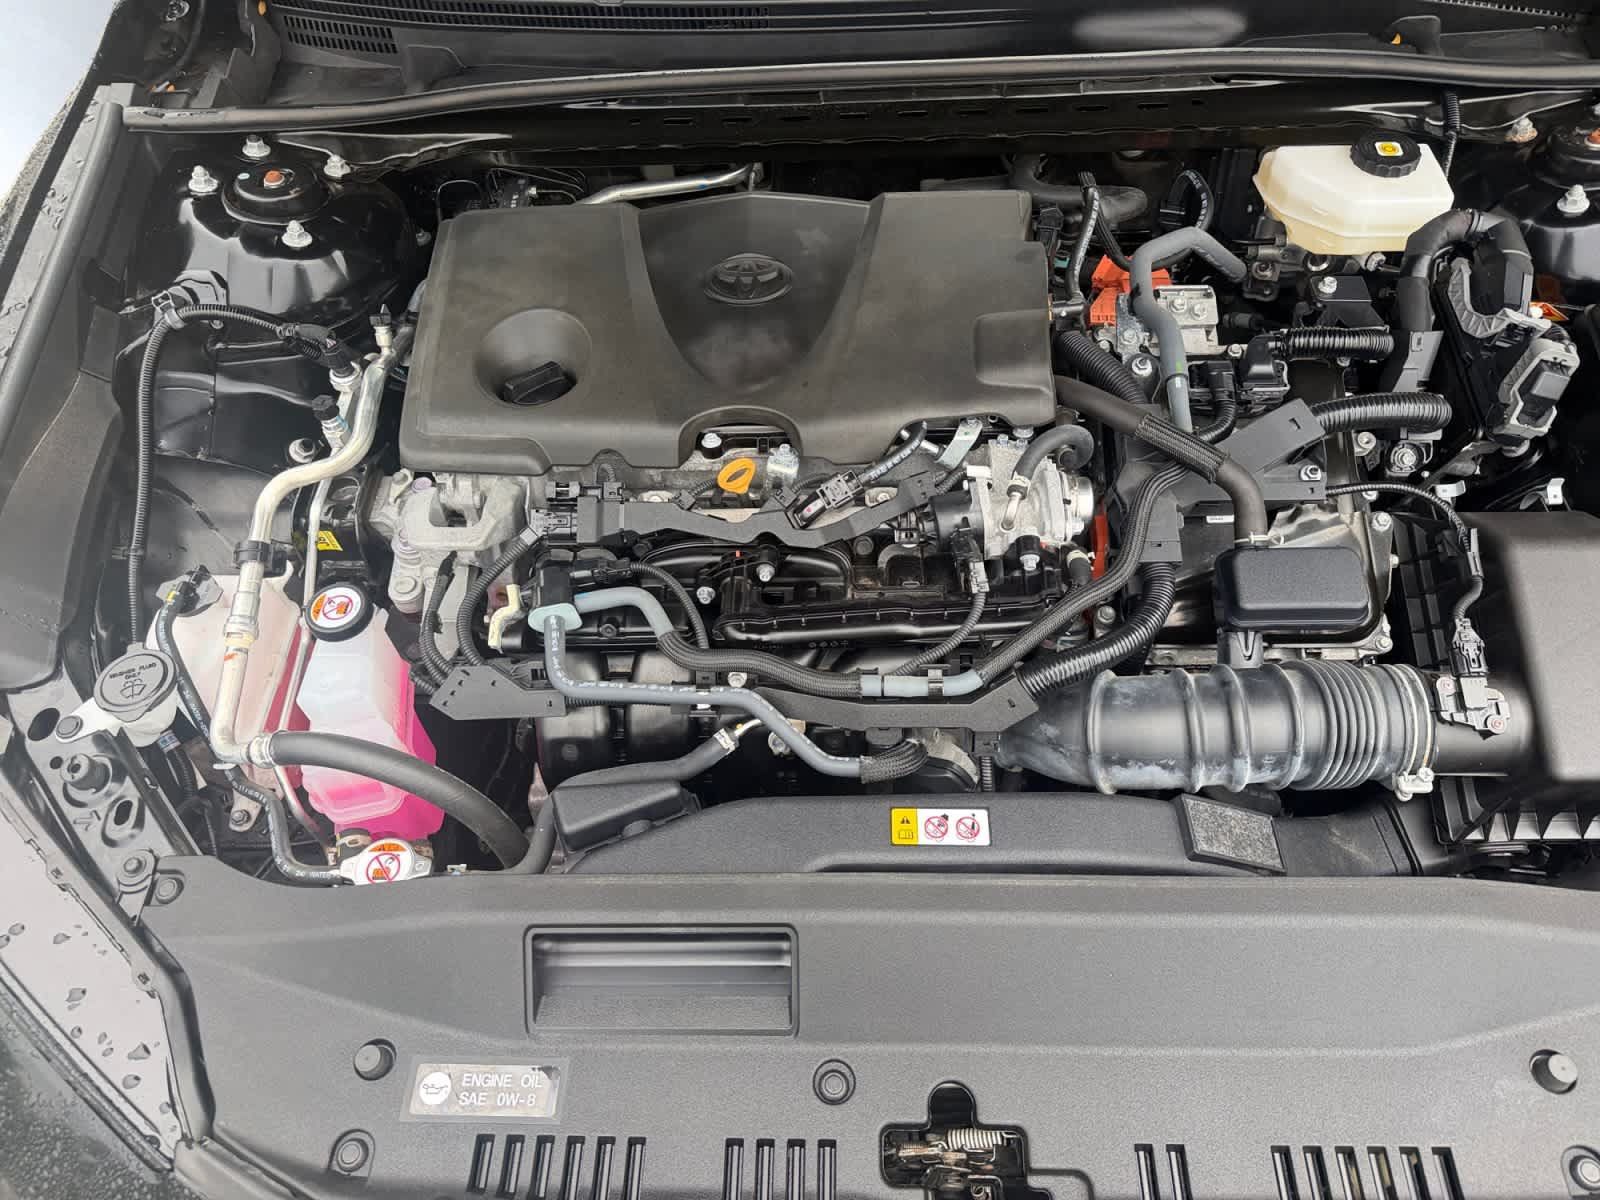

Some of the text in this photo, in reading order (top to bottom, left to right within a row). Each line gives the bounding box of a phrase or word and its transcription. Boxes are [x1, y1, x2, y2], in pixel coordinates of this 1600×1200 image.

[139, 662, 157, 671] FLUID
[461, 1073, 544, 1089] ENGINE OIL
[458, 1091, 536, 1107] SAE 0W-8
